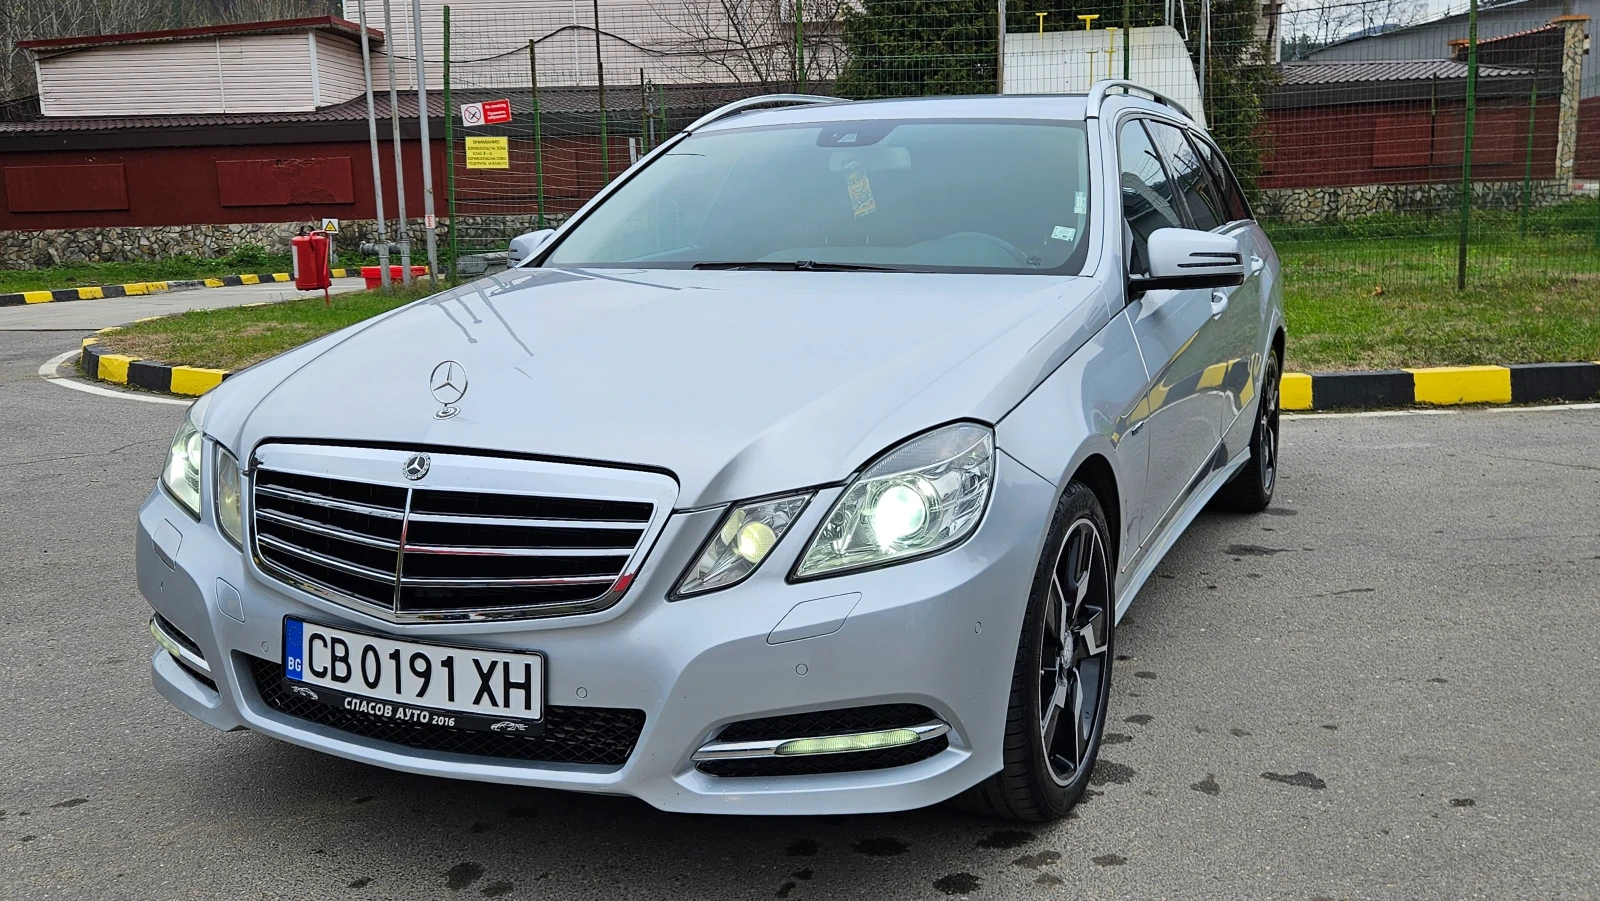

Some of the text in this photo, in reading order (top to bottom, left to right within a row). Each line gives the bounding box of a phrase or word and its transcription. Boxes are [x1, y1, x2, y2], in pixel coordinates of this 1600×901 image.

[288, 656, 302, 671] BG
[308, 633, 532, 711] CB 0191 XH
[344, 697, 456, 727] СПАСОВ АУТО 2016
